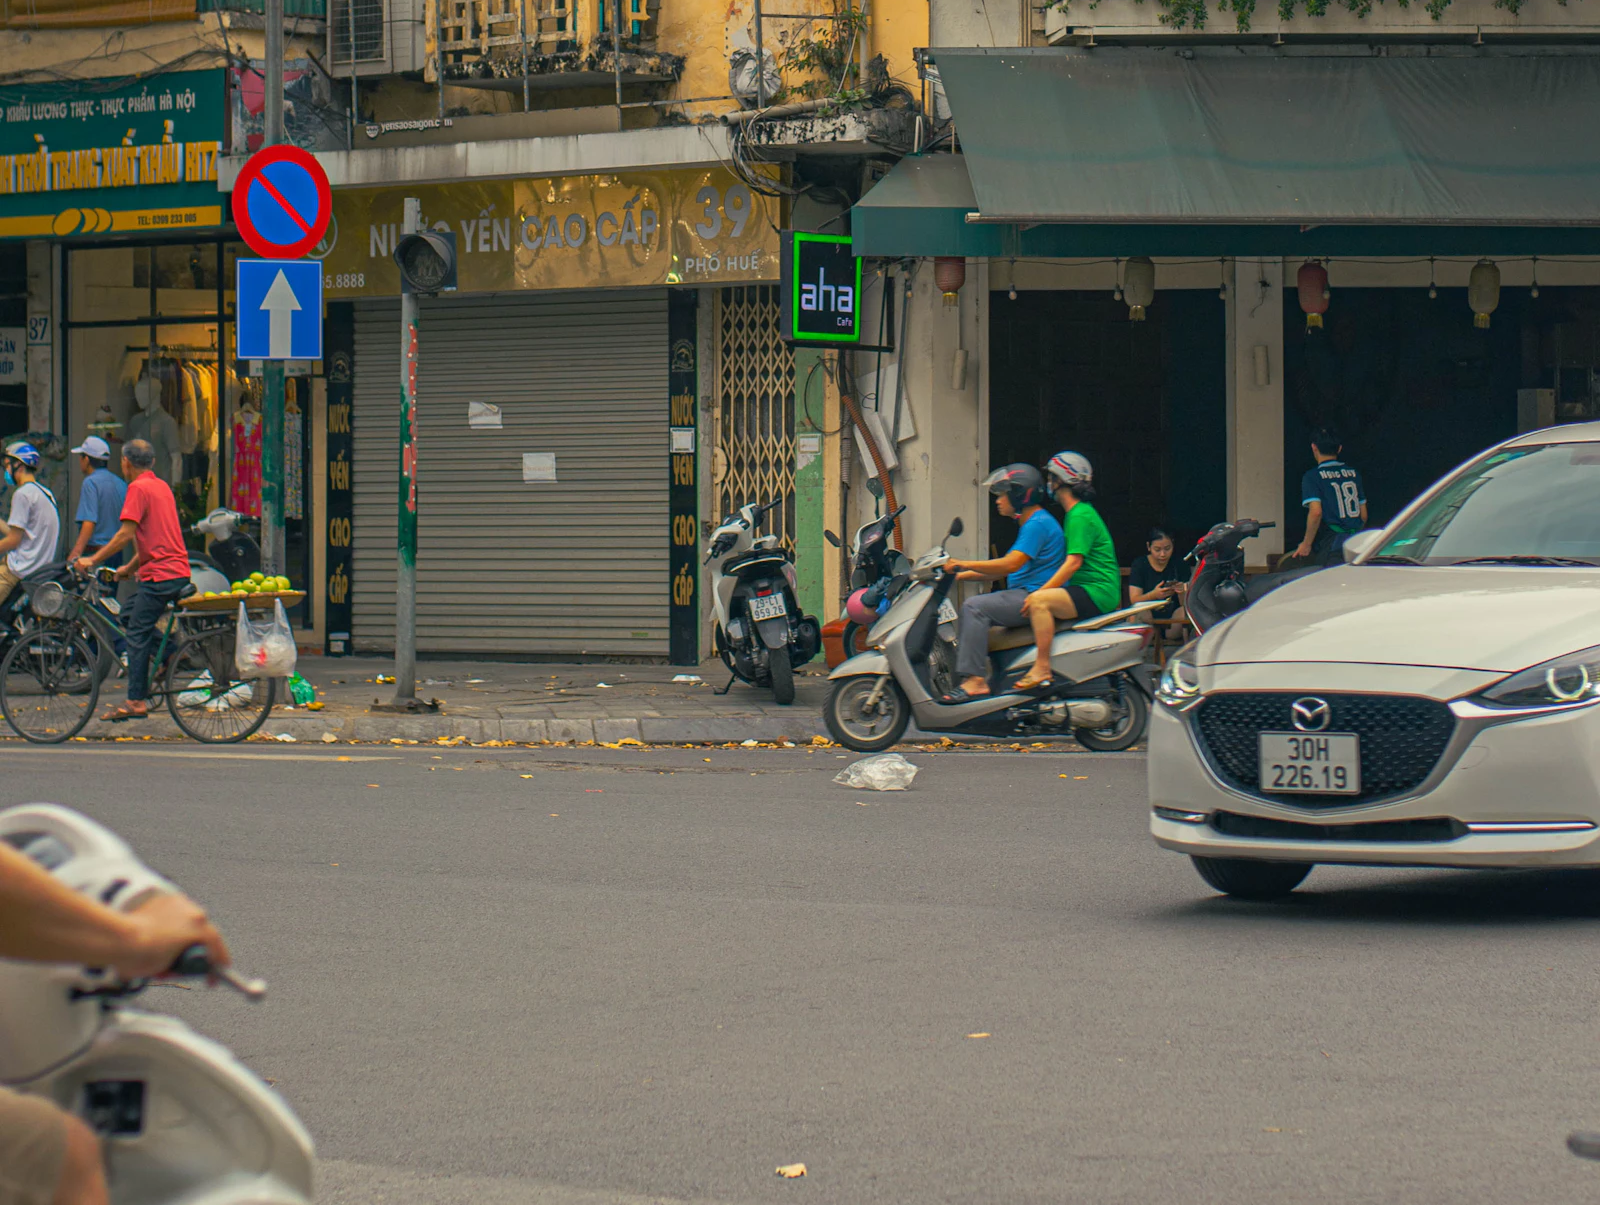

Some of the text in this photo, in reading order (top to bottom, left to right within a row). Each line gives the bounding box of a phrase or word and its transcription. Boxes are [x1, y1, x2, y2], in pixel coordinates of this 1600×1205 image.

[160, 89, 172, 111] HÀ
[176, 88, 196, 113] NỘI
[186, 141, 222, 182] RITZ
[460, 203, 510, 253] YẾN
[521, 213, 587, 249] CAO
[596, 194, 657, 246] CẤP
[695, 184, 751, 240] 39
[685, 248, 761, 273] PHỐ HUẾ
[801, 267, 853, 313] aha
[1330, 481, 1360, 518] 18
[329, 517, 351, 547] CAO
[673, 514, 696, 546] CAO
[1287, 737, 1329, 761] 30H
[1272, 764, 1347, 789] 226.19
